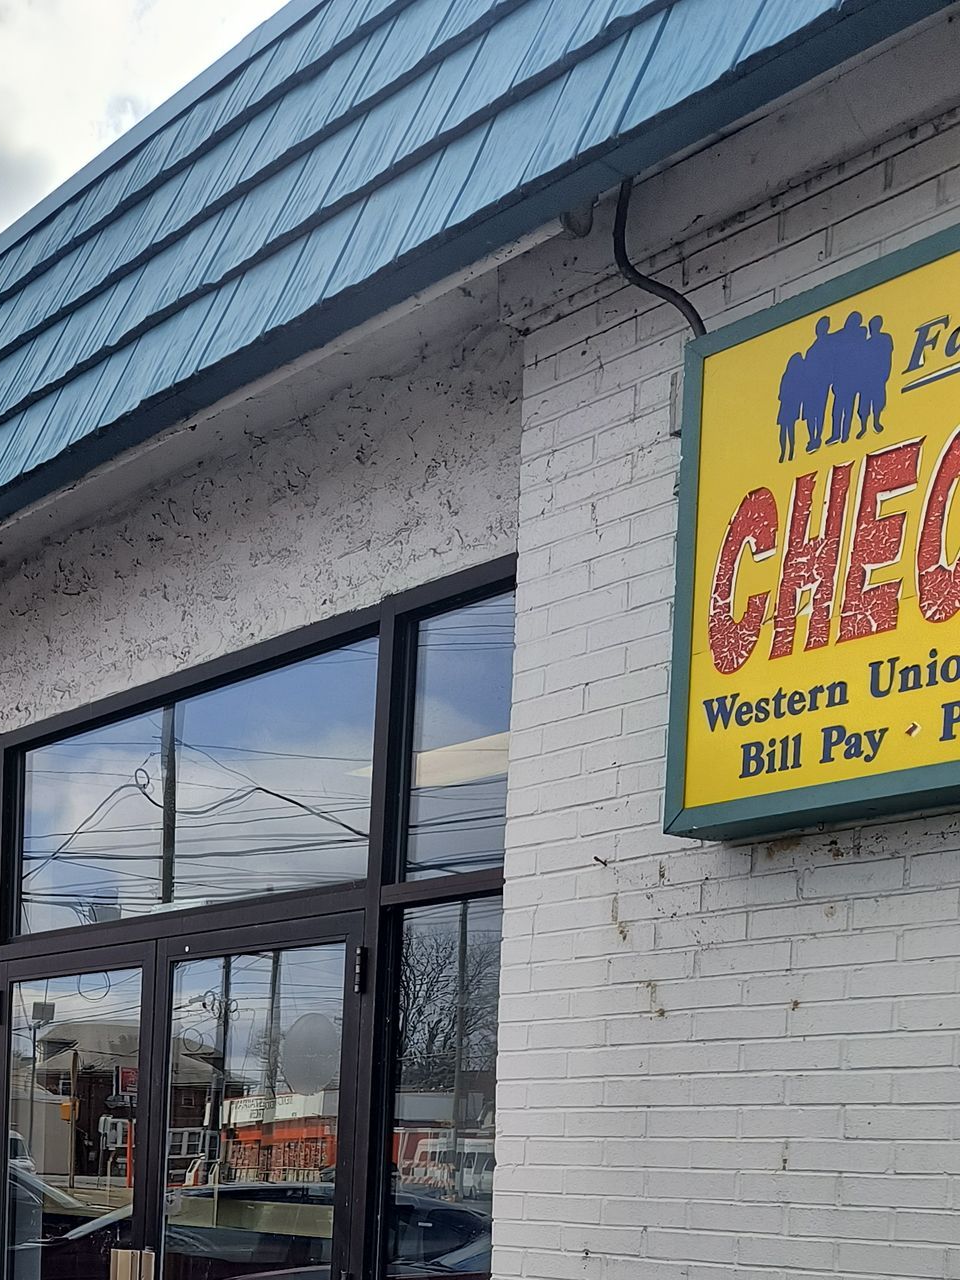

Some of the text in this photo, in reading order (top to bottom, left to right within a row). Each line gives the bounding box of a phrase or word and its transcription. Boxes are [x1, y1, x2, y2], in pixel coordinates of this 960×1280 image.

[708, 427, 960, 675] CHEC
[703, 648, 960, 732] Western Unio
[739, 732, 802, 779] Bill
[819, 725, 889, 762] Pay
